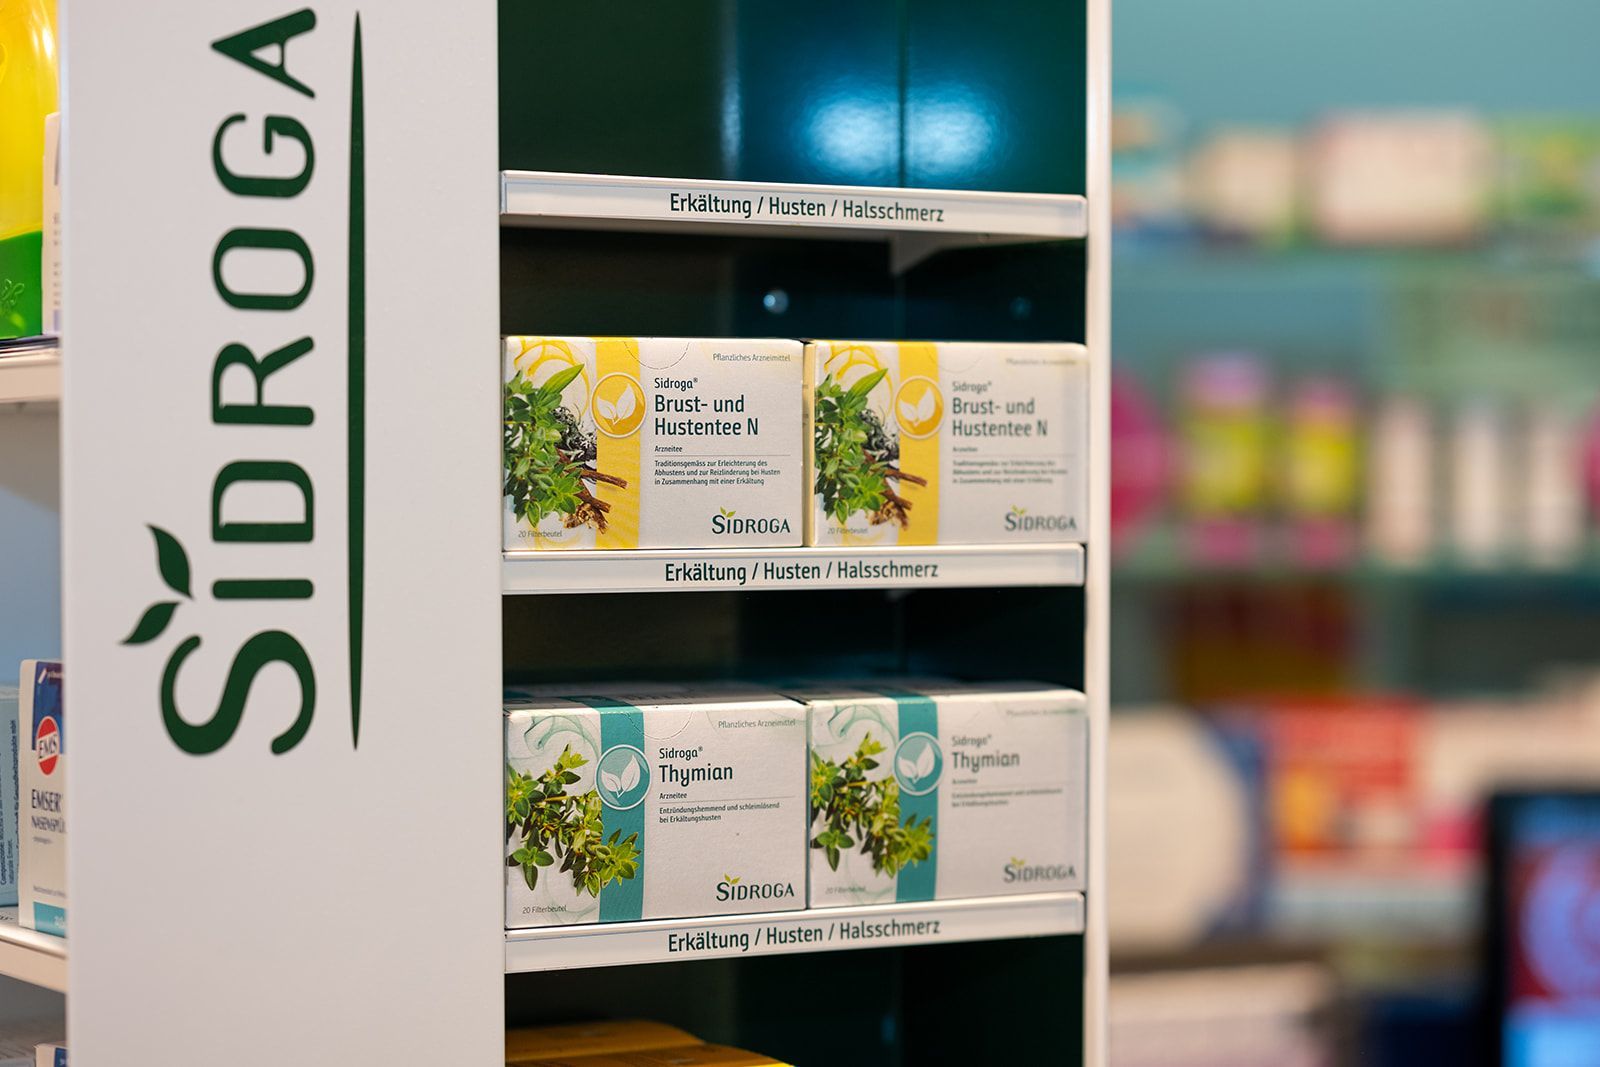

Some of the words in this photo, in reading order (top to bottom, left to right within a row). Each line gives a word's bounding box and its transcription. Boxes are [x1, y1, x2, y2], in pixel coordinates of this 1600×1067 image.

[670, 193, 752, 219] Erkältung
[756, 196, 764, 214] /
[769, 197, 826, 216] Husten
[831, 200, 838, 217] /
[842, 200, 944, 222] Halsschmerz
[712, 353, 751, 362] Pflanzliches
[752, 354, 791, 362] Arzneimittel
[160, 7, 316, 756] SIDROGA
[655, 394, 708, 413] Brust-
[714, 394, 745, 413] und
[952, 397, 1002, 414] Brust-
[1006, 397, 1035, 414] und
[655, 417, 741, 436] Hustentee
[747, 417, 759, 436] N
[952, 419, 1032, 436] Hustentee
[1037, 419, 1048, 436] N
[654, 460, 706, 468] Traditionsgemäss
[718, 460, 757, 468] Erleichterung
[710, 469, 750, 477] Reizlinderung
[661, 478, 708, 486] Zusammenhang
[736, 477, 765, 486] Erkältung
[712, 514, 791, 535] SIDROGA
[1004, 512, 1077, 532] SIDROGA
[518, 530, 526, 538] 20
[664, 563, 747, 585] Erkältung
[751, 563, 759, 580] /
[764, 563, 821, 580] Husten
[826, 562, 833, 579] /
[838, 560, 939, 579] Halsschmerz
[718, 720, 756, 728] Pflanzliches
[38, 734, 59, 760] EMS
[952, 750, 1020, 773] Thymian
[659, 763, 733, 787] Thymian
[659, 792, 687, 800] Arzneitee
[659, 805, 726, 815] Entzündungshemmend
[659, 816, 669, 824] bei
[670, 814, 722, 823] Erkältungshusten
[1003, 863, 1076, 883] SIDROGA
[716, 881, 795, 902] SIDROGA
[522, 906, 531, 914] 20
[668, 930, 749, 953] Erkältung
[754, 928, 762, 946] /
[766, 926, 823, 945] Husten
[828, 923, 835, 941] /
[840, 919, 941, 940] Halsschmerz
